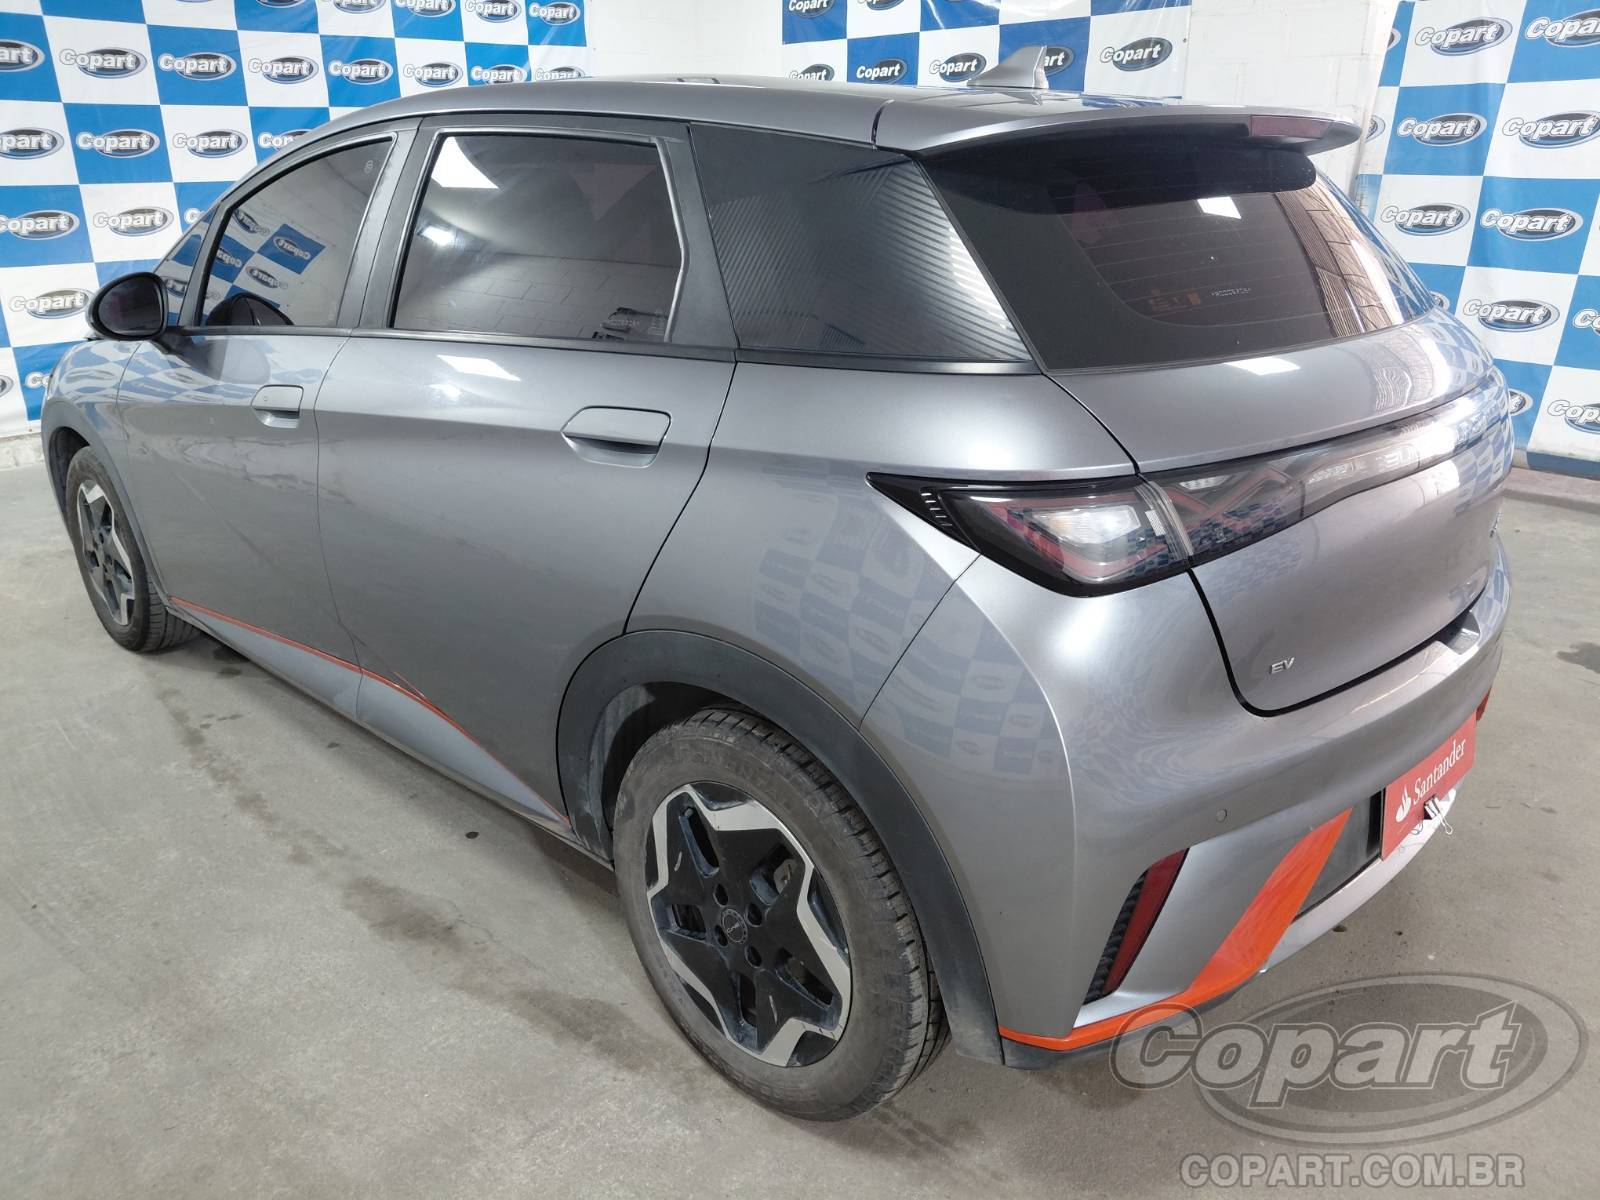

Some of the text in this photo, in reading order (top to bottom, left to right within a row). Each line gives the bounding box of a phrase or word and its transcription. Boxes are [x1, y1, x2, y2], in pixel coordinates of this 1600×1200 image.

[529, 3, 575, 20] Copart
[1415, 22, 1501, 49] Copart
[1525, 17, 1600, 42] Copa
[60, 48, 137, 69] Copart
[159, 53, 228, 74] Copart
[1100, 43, 1162, 65] Copart
[248, 58, 311, 76] Copart
[328, 60, 387, 78] Copart
[403, 63, 457, 81] Copart
[471, 65, 520, 82] Copart
[856, 63, 900, 80] Copart
[929, 58, 978, 75] Copart
[1397, 116, 1479, 137] Copart
[1502, 113, 1600, 141] Copart
[76, 131, 153, 151] Copart
[172, 132, 238, 150] Copart
[93, 210, 165, 230] Copart
[1381, 205, 1462, 228] Copart
[1480, 208, 1572, 232] Copart
[8, 291, 87, 313] Copart
[1463, 298, 1549, 324] Copart
[1271, 656, 1295, 674] EV
[1413, 739, 1466, 805] Santander
